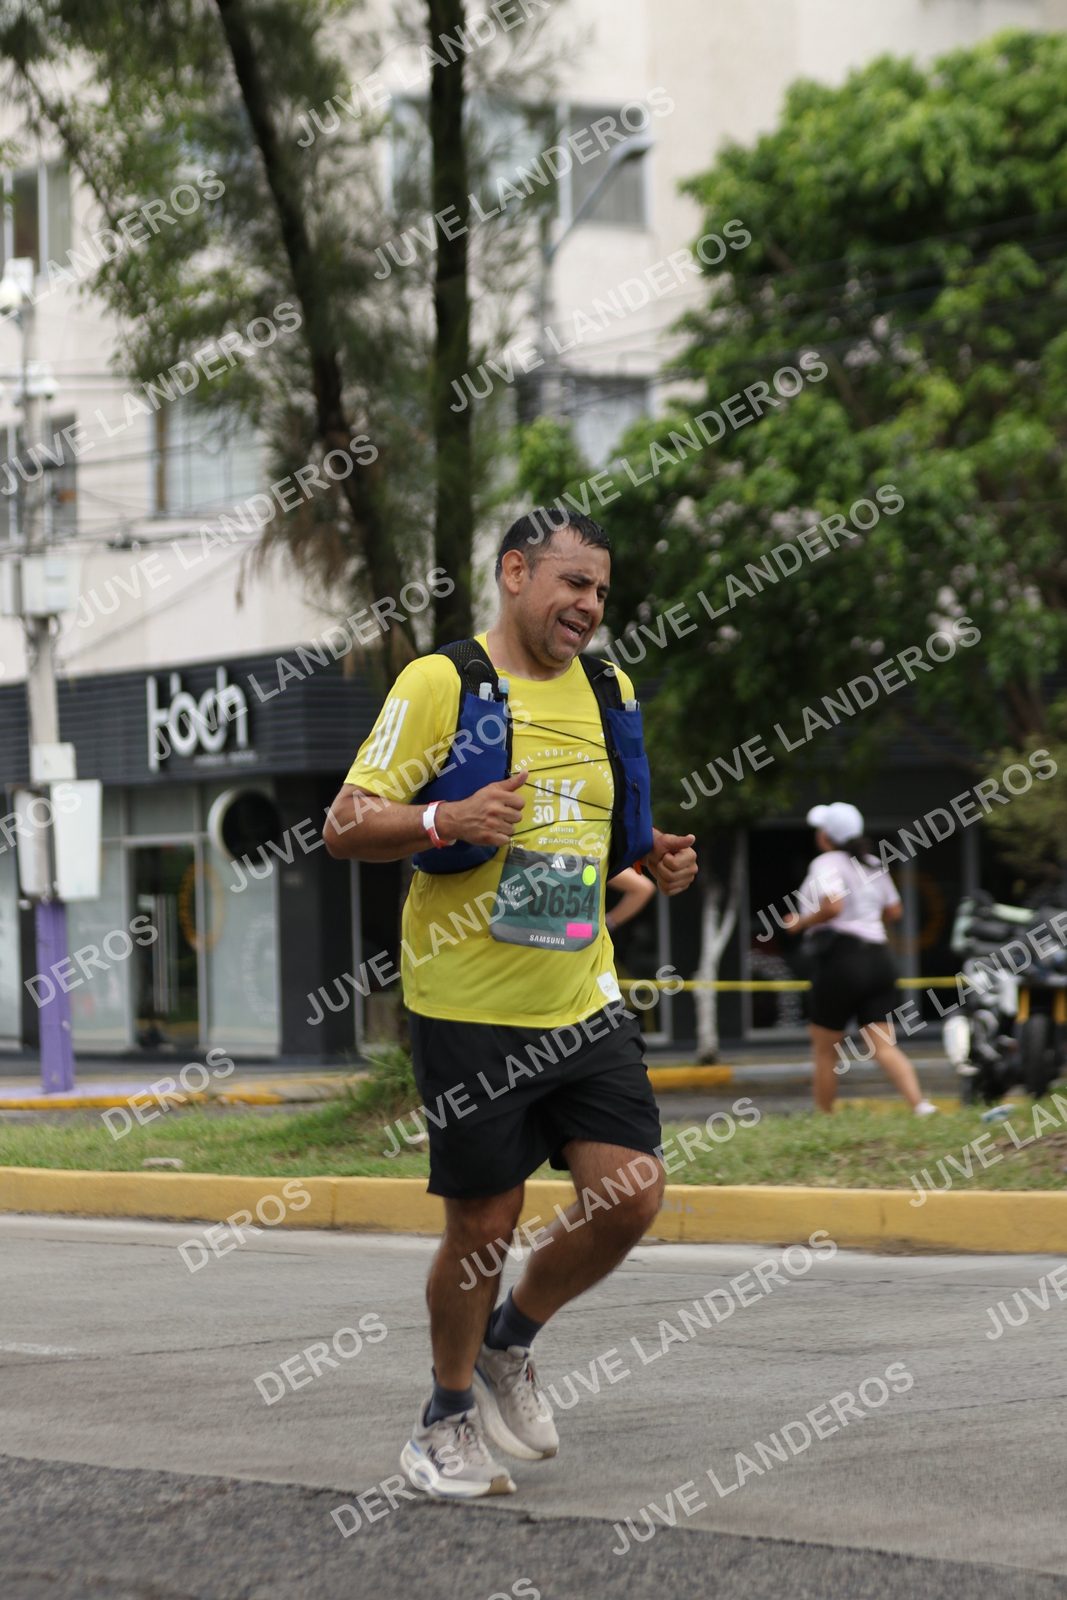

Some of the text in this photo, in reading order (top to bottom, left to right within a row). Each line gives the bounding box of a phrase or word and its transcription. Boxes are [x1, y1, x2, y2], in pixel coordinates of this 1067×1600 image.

[532, 804, 555, 824] 30
[559, 778, 587, 822] K
[528, 884, 596, 920] 0654
[529, 934, 566, 946] SAMSUNG
